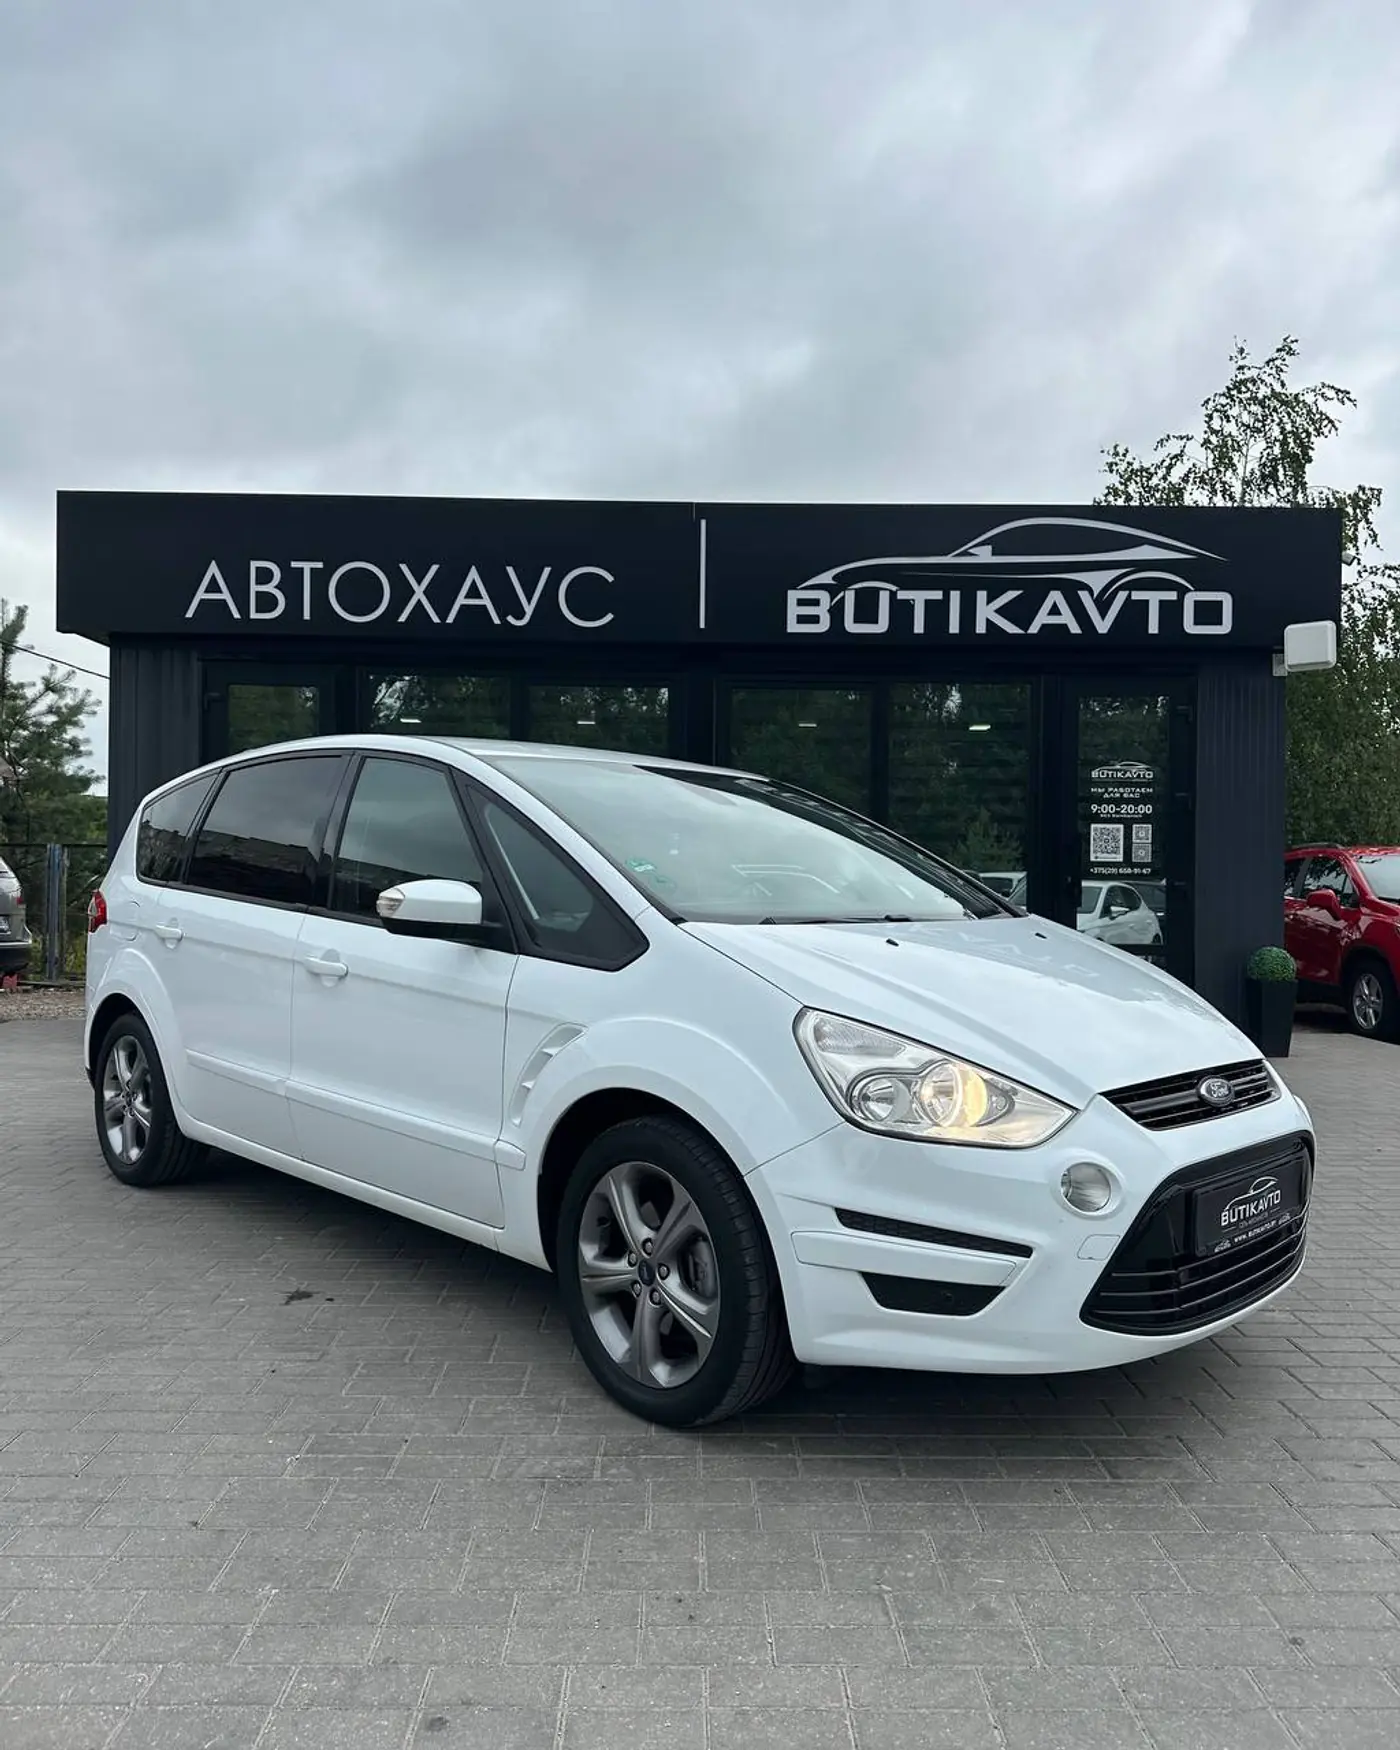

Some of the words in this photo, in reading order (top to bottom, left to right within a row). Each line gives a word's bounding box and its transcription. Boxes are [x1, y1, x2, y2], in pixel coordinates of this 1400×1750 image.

[185, 559, 616, 629] АВТОХАУС
[786, 589, 1233, 635] BUTIKAVTO
[1091, 770, 1154, 779] BUTIKAVTO
[1091, 804, 1153, 814] 9:00-20:00
[1221, 1190, 1281, 1226] BUTIKAVTO
